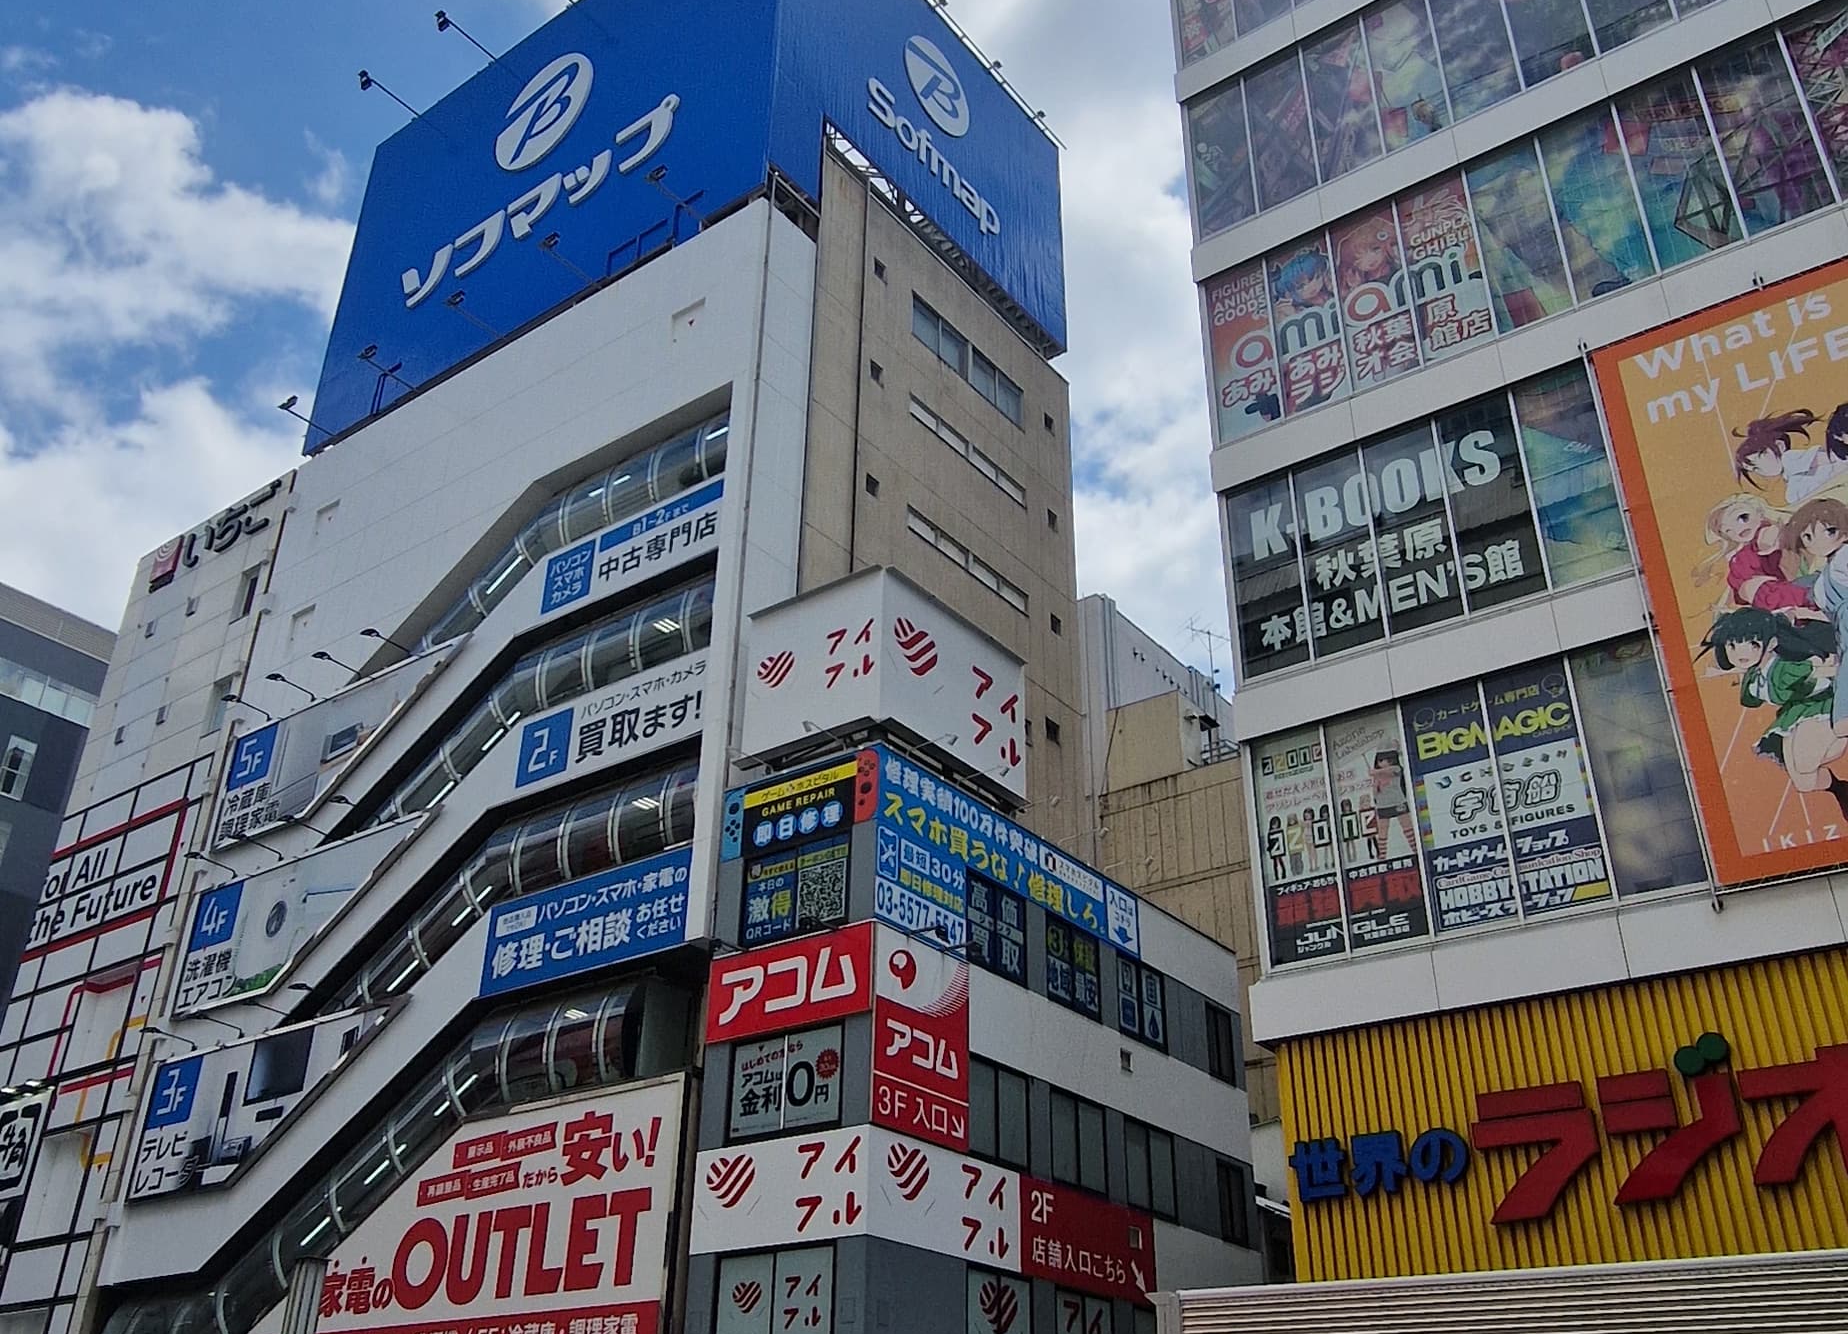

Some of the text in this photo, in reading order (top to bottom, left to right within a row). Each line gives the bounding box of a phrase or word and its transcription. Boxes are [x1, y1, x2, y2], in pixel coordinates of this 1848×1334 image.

[866, 76, 1000, 236] Sofmap
[401, 93, 681, 309] ソフマップ
[1410, 214, 1474, 248] GUNPLA
[1212, 269, 1264, 303] FIGURES
[1214, 285, 1265, 316] ANIME
[1214, 295, 1268, 327] GOODS
[1635, 290, 1833, 381] What is
[1647, 374, 1722, 425] my
[1249, 429, 1503, 562] K-BOOKS
[182, 479, 282, 568] いちご
[550, 548, 592, 578] パソコン
[598, 511, 718, 582] 中古専門店
[1315, 517, 1448, 591] 秋葉原
[550, 583, 583, 605] カメラ
[554, 567, 585, 589] スマホ
[580, 659, 708, 720] パソコン・スマホ・カメラ
[575, 688, 703, 765] 買取ます!
[1416, 701, 1571, 762] BIGMAGIC
[235, 738, 264, 779] 5F
[527, 728, 557, 773] 2F
[223, 780, 271, 818] 冷蔵庫
[761, 787, 836, 818] GAME REPAIR
[1450, 768, 1562, 824] 宇宙船
[216, 799, 281, 842] 調理家電
[1450, 823, 1489, 840] TOYS
[1510, 803, 1577, 826] FIGURES
[72, 845, 110, 893] All
[1572, 846, 1602, 863] Shop
[72, 871, 157, 934] Future
[538, 866, 688, 924] パソコン・スマホ・家電の
[758, 877, 785, 892] 本日の
[1109, 890, 1134, 917] 入口は
[200, 894, 229, 937] 4F
[635, 893, 686, 924] お任せ
[636, 915, 682, 940] ください
[747, 889, 793, 925] 激得
[492, 908, 634, 980] 修理・ご相談
[746, 918, 793, 941] QRコード
[182, 946, 231, 983] 洗濯機
[718, 946, 858, 1027] アコム
[176, 972, 237, 1010] エアコン
[885, 1017, 959, 1080] アコム
[157, 1067, 185, 1116] 3F
[877, 1085, 948, 1135] 3F 入口
[142, 1131, 189, 1163] テレビ
[559, 1111, 663, 1187] 安い!
[797, 1135, 862, 1180] アイ
[1289, 1127, 1471, 1204] 世界の
[134, 1155, 212, 1194] レコーダー
[521, 1166, 559, 1190] だから
[961, 1163, 1008, 1212] アイ
[795, 1190, 863, 1233] フル
[1030, 1189, 1055, 1224] 2F
[391, 1186, 653, 1311] OUTLET
[961, 1216, 1010, 1260] フル
[1031, 1235, 1127, 1285] 店舗入口こちら
